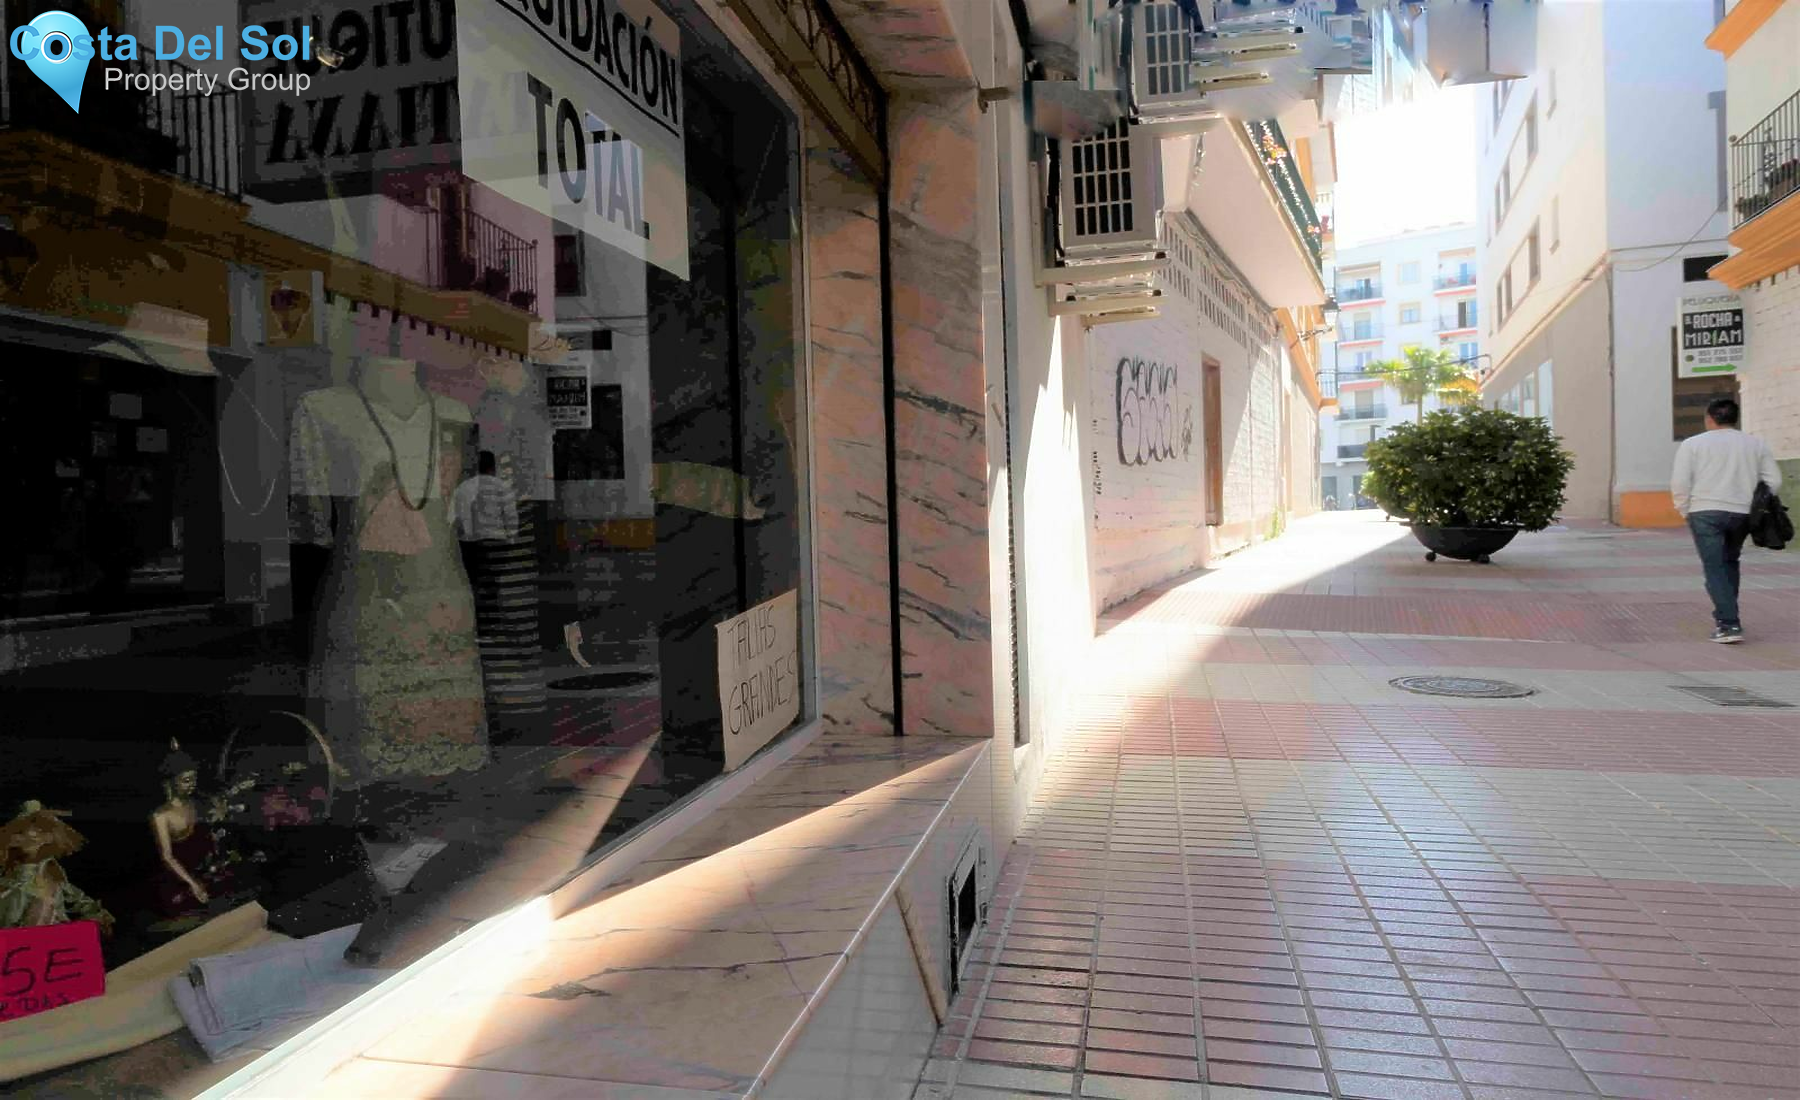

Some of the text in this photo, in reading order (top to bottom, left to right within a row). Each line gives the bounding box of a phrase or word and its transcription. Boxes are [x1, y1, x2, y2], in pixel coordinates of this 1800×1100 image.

[526, 71, 651, 240] TOTAL
[1693, 311, 1733, 329] ROCHA
[1685, 329, 1742, 347] MIRIAM
